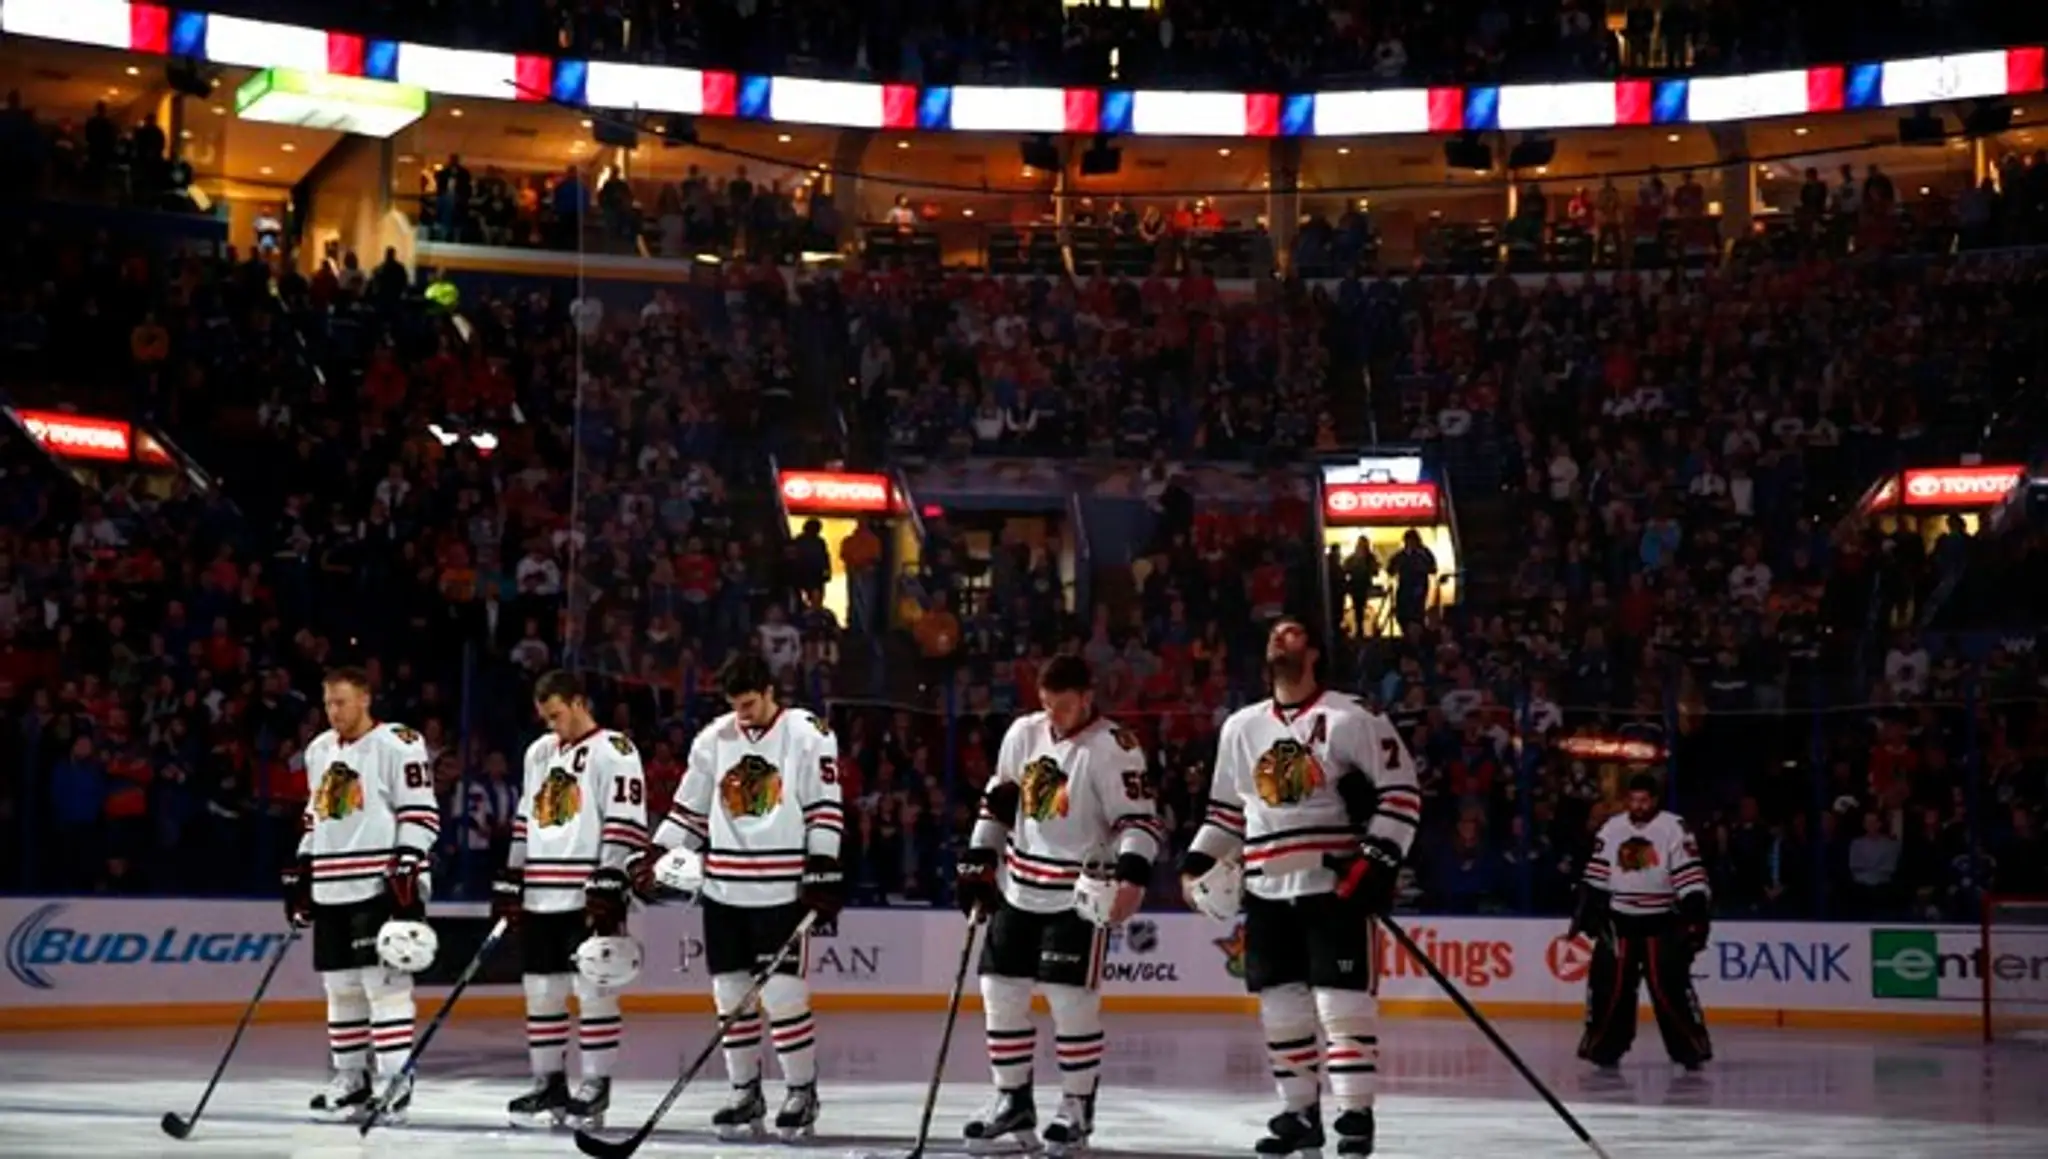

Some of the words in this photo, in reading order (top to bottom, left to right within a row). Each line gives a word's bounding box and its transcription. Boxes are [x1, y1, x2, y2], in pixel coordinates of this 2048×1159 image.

[1360, 490, 1434, 509] TOYOTA
[572, 746, 590, 773] C
[612, 776, 643, 806] 19
[27, 927, 148, 964] BUD
[1713, 940, 1853, 983] BANK
